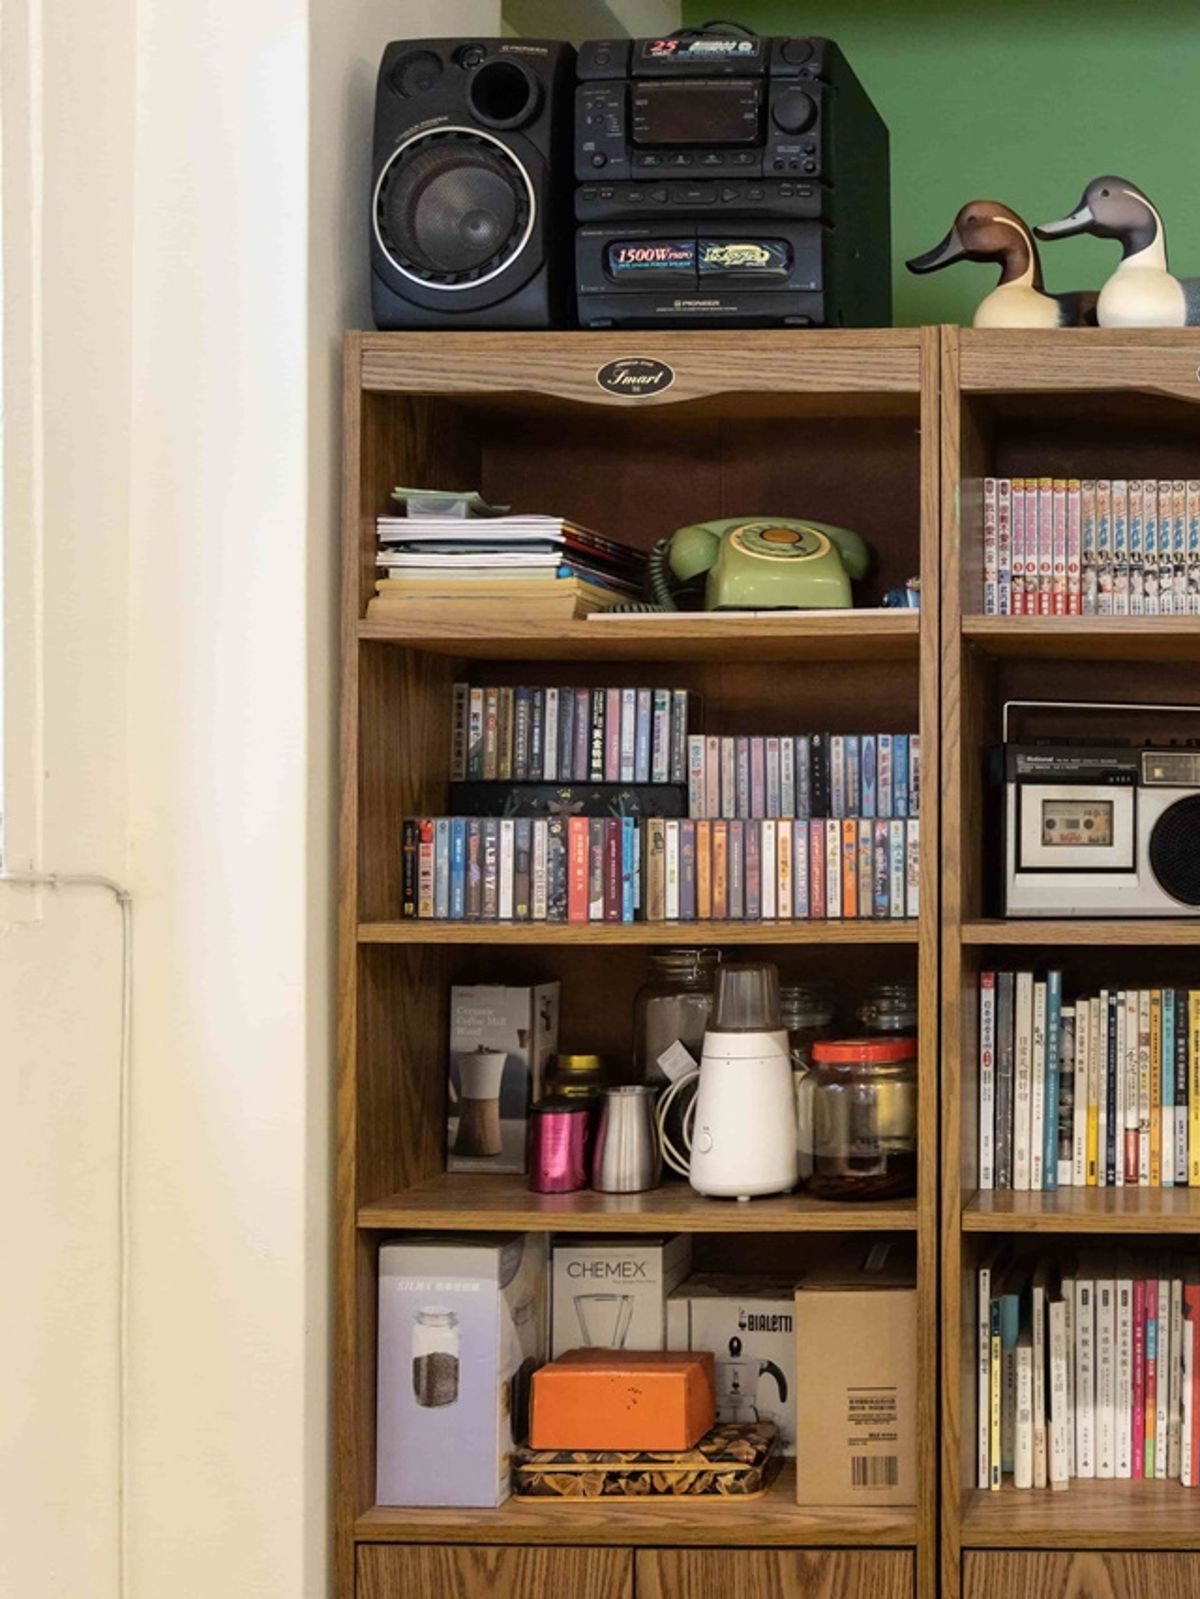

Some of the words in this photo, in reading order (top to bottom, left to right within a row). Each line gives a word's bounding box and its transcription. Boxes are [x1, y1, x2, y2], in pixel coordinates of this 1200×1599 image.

[619, 248, 667, 262] 1500W
[607, 369, 664, 385] Smart
[567, 1260, 647, 1279] CHEMEX
[747, 1314, 792, 1333] BIALETTI
